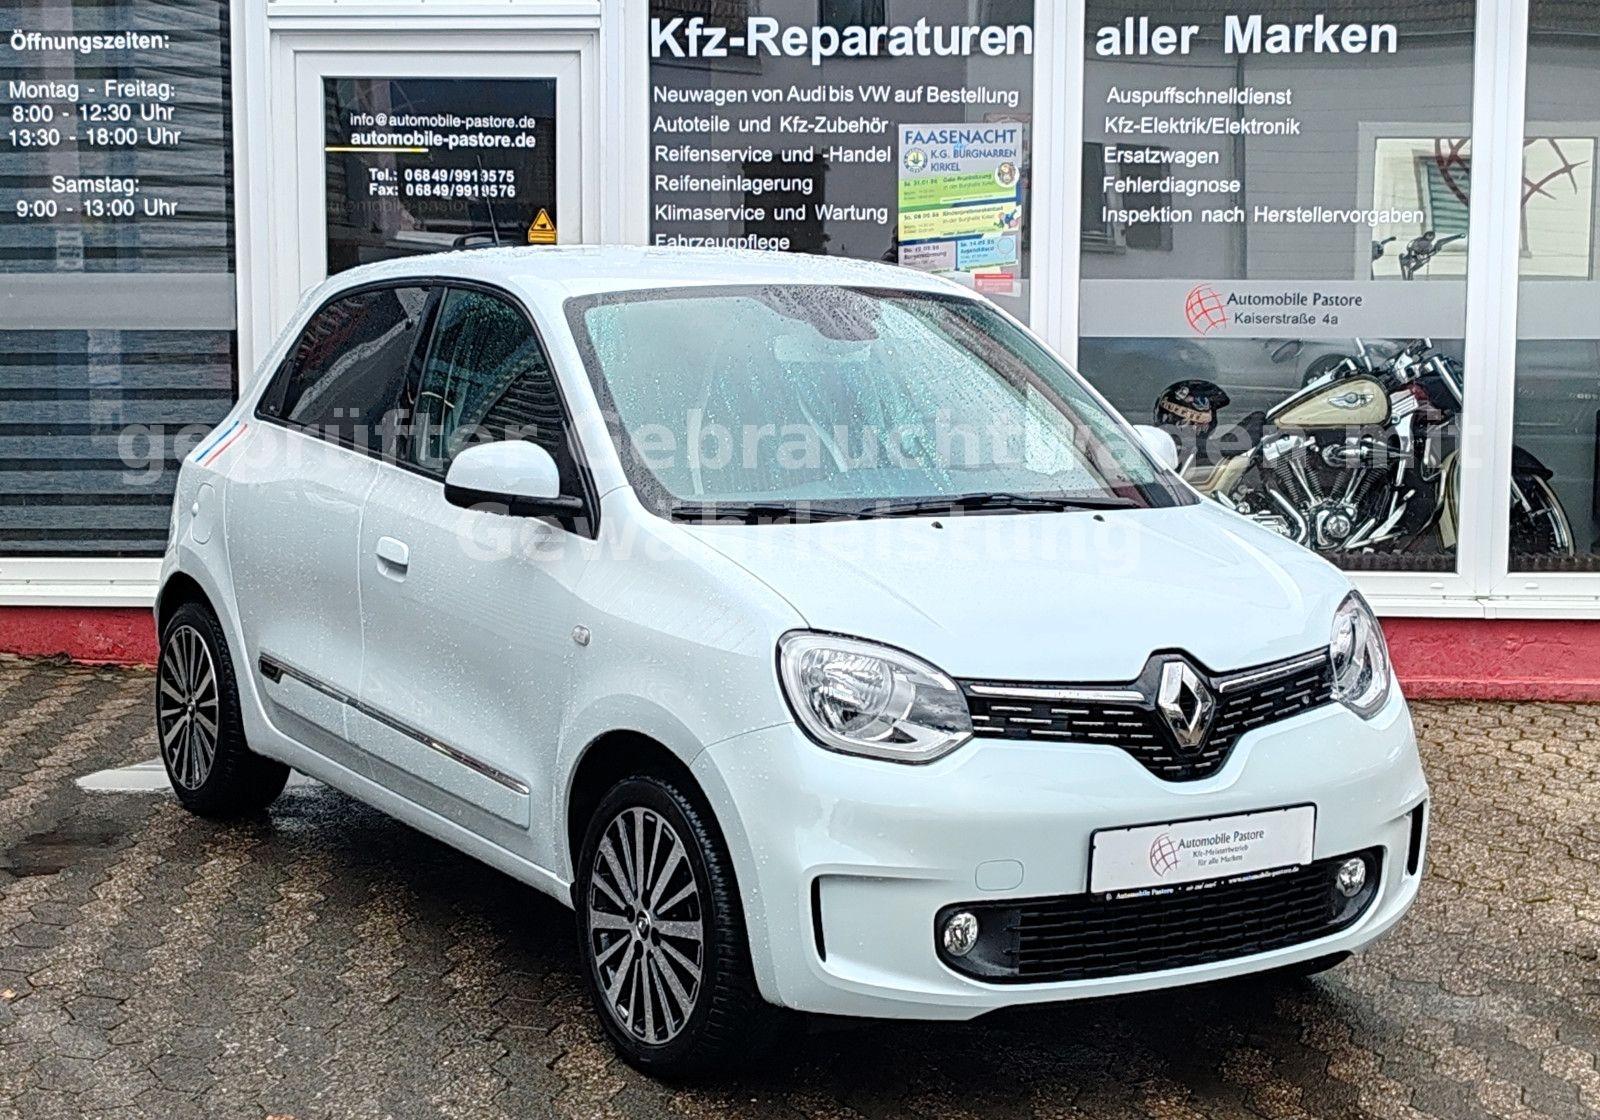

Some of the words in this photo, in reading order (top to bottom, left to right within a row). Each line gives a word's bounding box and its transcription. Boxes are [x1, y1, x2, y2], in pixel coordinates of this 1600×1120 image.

[10, 28, 170, 54] Öffnungszeiten:
[650, 16, 1033, 66] Kfz-Reparaturen
[1095, 16, 1199, 55] aller
[1224, 14, 1397, 54] Marken
[9, 80, 79, 102] Montag
[104, 79, 175, 102] Freitag:
[654, 86, 748, 107] Neuwagen
[751, 89, 783, 103] von
[786, 85, 826, 102] Audi
[829, 85, 854, 102] bis
[858, 85, 891, 102] VW
[894, 85, 924, 103] auf
[926, 86, 1019, 108] Bestellung
[1106, 85, 1292, 106] Auspuffschnelldienst
[12, 104, 54, 123] 8:00
[79, 103, 131, 122] 12:30
[140, 103, 175, 122] Uhr
[349, 112, 536, 131] info@automobile-pastore.de
[653, 115, 730, 133] Autoteile
[738, 115, 771, 133] und
[780, 115, 889, 133] Kfz-Zubehör
[1104, 116, 1300, 135] Kfz-Elektrik/Elektronik
[8, 128, 60, 147] 13:30
[86, 127, 138, 146] 18:00
[147, 126, 182, 145] Uhr
[350, 131, 536, 149] automobile-pastore.de
[904, 129, 1017, 145] FAASENACHT
[655, 144, 773, 163] Reifenservice
[781, 145, 814, 163] und
[822, 145, 891, 163] -Handel
[930, 149, 949, 159] K.G.
[1104, 147, 1219, 167] Ersatzwagen
[368, 167, 398, 182] Tel.:
[404, 168, 515, 183] 06849/9919575
[930, 162, 961, 172] KIRKEL
[52, 175, 140, 195] Samstag:
[369, 182, 399, 197] Fax:
[654, 174, 813, 195] Reifeneinlagerung
[1103, 176, 1241, 196] Fehlerdiagnose
[16, 199, 58, 218] 9:00
[83, 198, 135, 217] 13:00
[144, 198, 178, 216] Uhr
[655, 203, 765, 222] Klimaservice
[773, 204, 806, 222] und
[815, 204, 888, 226] Wartung
[1102, 205, 1193, 226] Inspektion
[1201, 206, 1245, 224] nach
[1254, 206, 1424, 226] Herstellervorgaben
[654, 233, 790, 250] Fahrzeugpflege
[1226, 292, 1308, 307] Automobile
[1312, 292, 1363, 307] Pastore
[1233, 312, 1316, 326] Kaiserstraße
[1321, 312, 1339, 326] 4a
[1176, 832, 1231, 850] Automobile
[1233, 829, 1265, 843] Pastore
